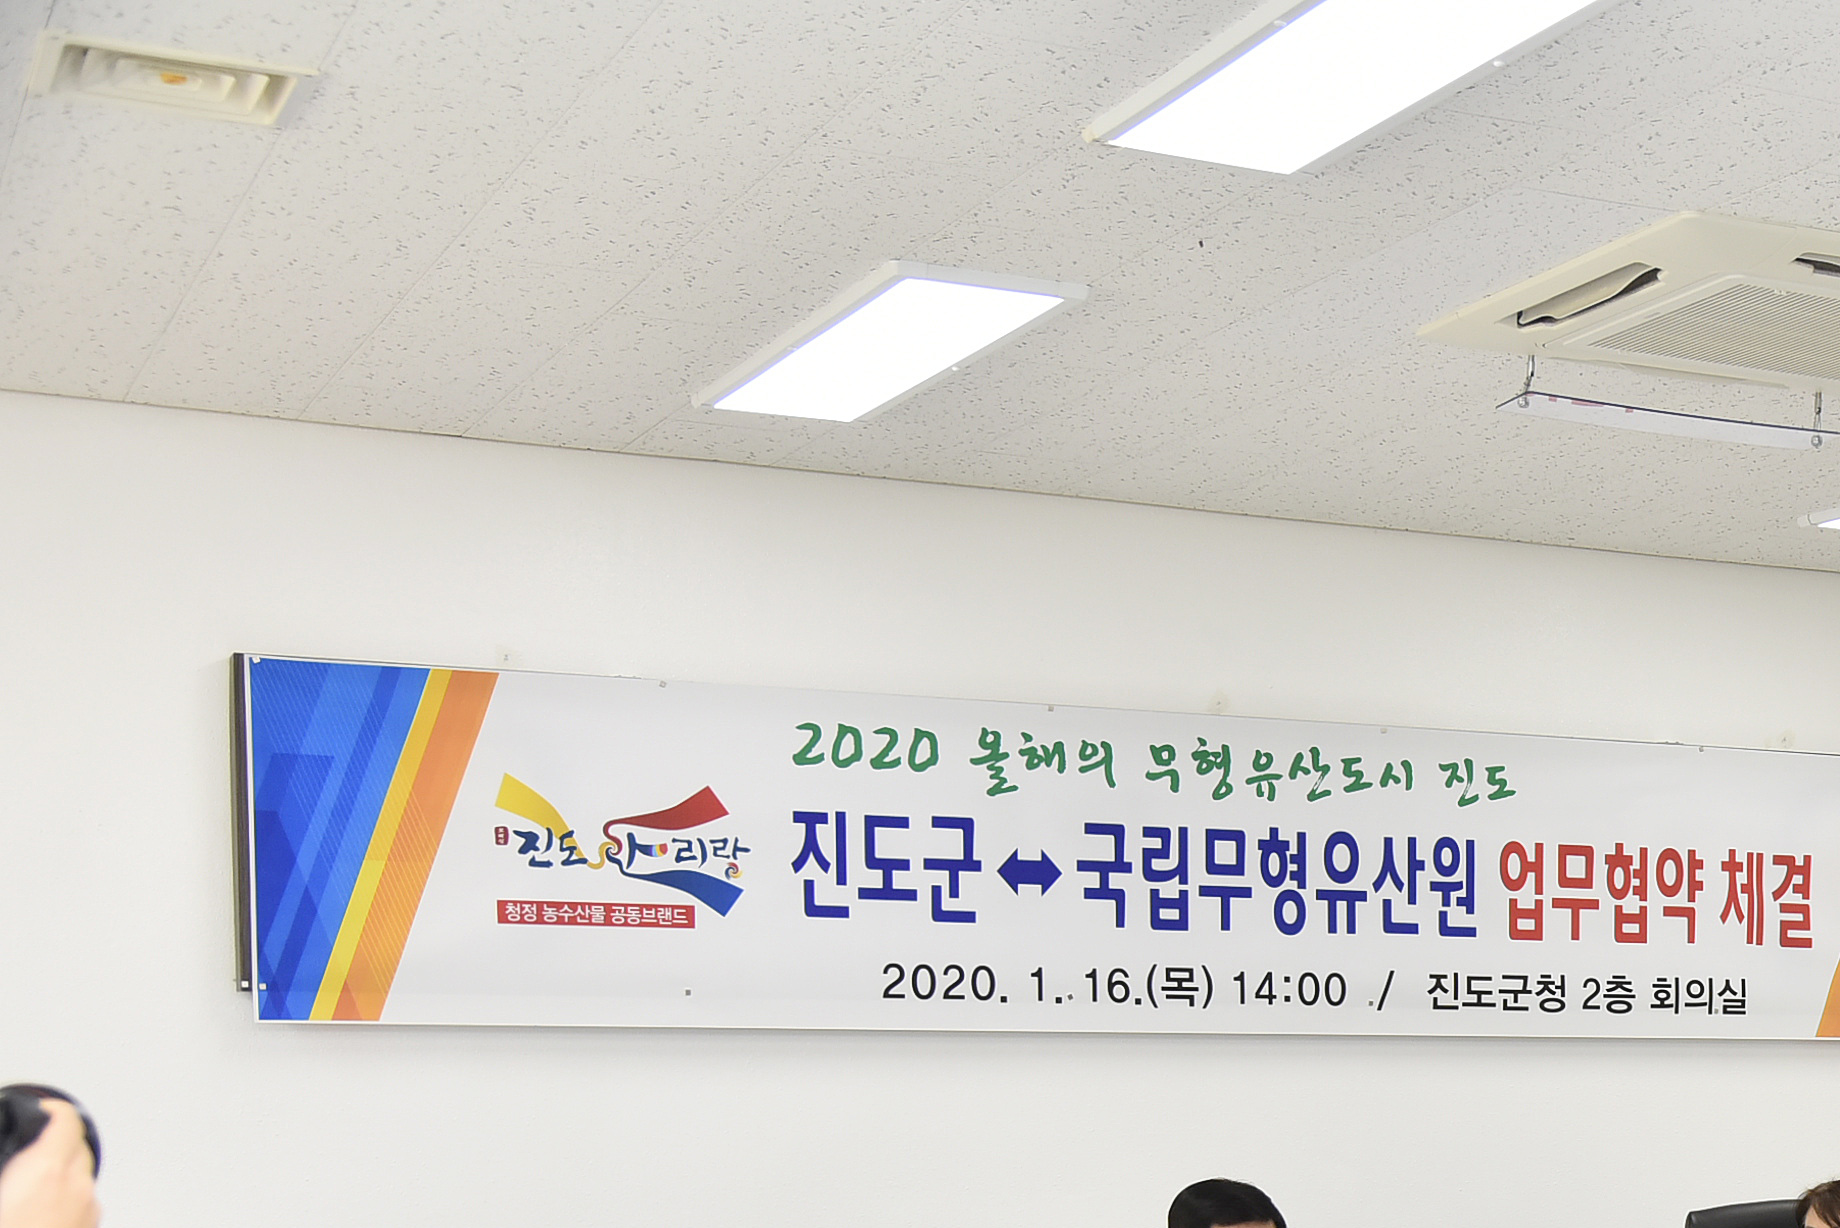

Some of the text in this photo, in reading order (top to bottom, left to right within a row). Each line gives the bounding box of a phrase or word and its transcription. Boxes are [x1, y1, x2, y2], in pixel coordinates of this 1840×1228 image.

[793, 722, 1516, 807] 2020 올해의 무형유산도시 진도
[505, 903, 689, 926] 청정 농수산물 공동브랜드
[792, 811, 1478, 938] 진도군 국립무형유산원
[1500, 841, 1813, 949] 업무협약 체결
[882, 963, 1008, 1003] 2020.
[1085, 964, 1213, 1009] 16.(목)
[1233, 971, 1346, 1007] 14:00
[1376, 970, 1395, 1011] /
[1427, 972, 1566, 1013] 진도군청
[1582, 975, 1636, 1014] 2층
[1650, 977, 1747, 1015] 회의실
